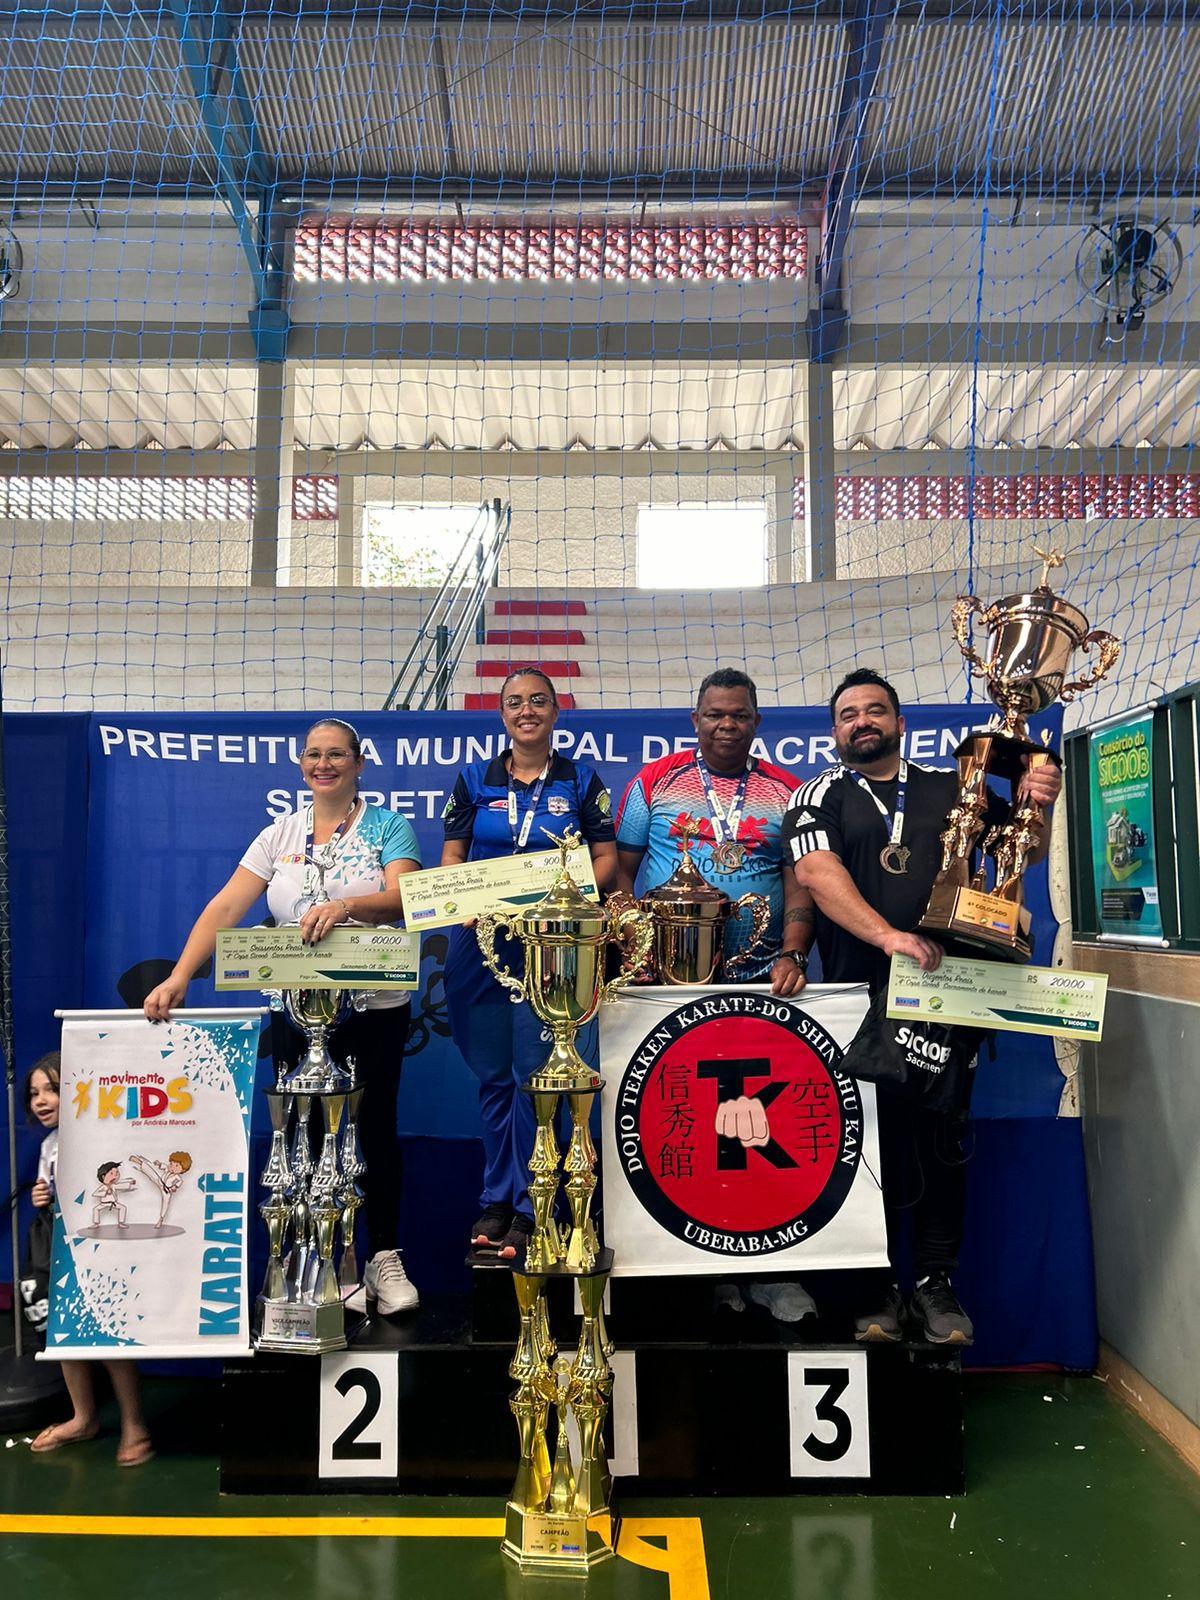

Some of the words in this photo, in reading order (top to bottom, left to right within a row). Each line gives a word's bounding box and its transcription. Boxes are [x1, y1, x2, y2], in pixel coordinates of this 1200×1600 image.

[1134, 730, 1145, 747] do
[1098, 747, 1150, 786] SICOOB
[524, 860, 533, 869] R$
[350, 936, 360, 944] R$
[921, 971, 953, 983] Duzentos
[1027, 975, 1038, 984] R$
[676, 997, 791, 1030] KARATE-DO
[1067, 1019, 1088, 1028] SICOOB
[99, 1070, 165, 1086] movimento
[622, 1028, 673, 1108] TEKKEN
[98, 1076, 193, 1121] KIDS
[168, 1119, 196, 1127] Marques
[657, 1063, 695, 1180] 信秀館
[792, 1077, 834, 1164] 空手
[620, 1114, 644, 1174] DOJO
[841, 1118, 859, 1167] KAN
[683, 1220, 808, 1252] UBERABA-MG
[198, 1171, 244, 1336] KARATÊ
[332, 1367, 382, 1460] 2
[802, 1368, 853, 1462] 3
[540, 1529, 570, 1537] CAMPEÃO
